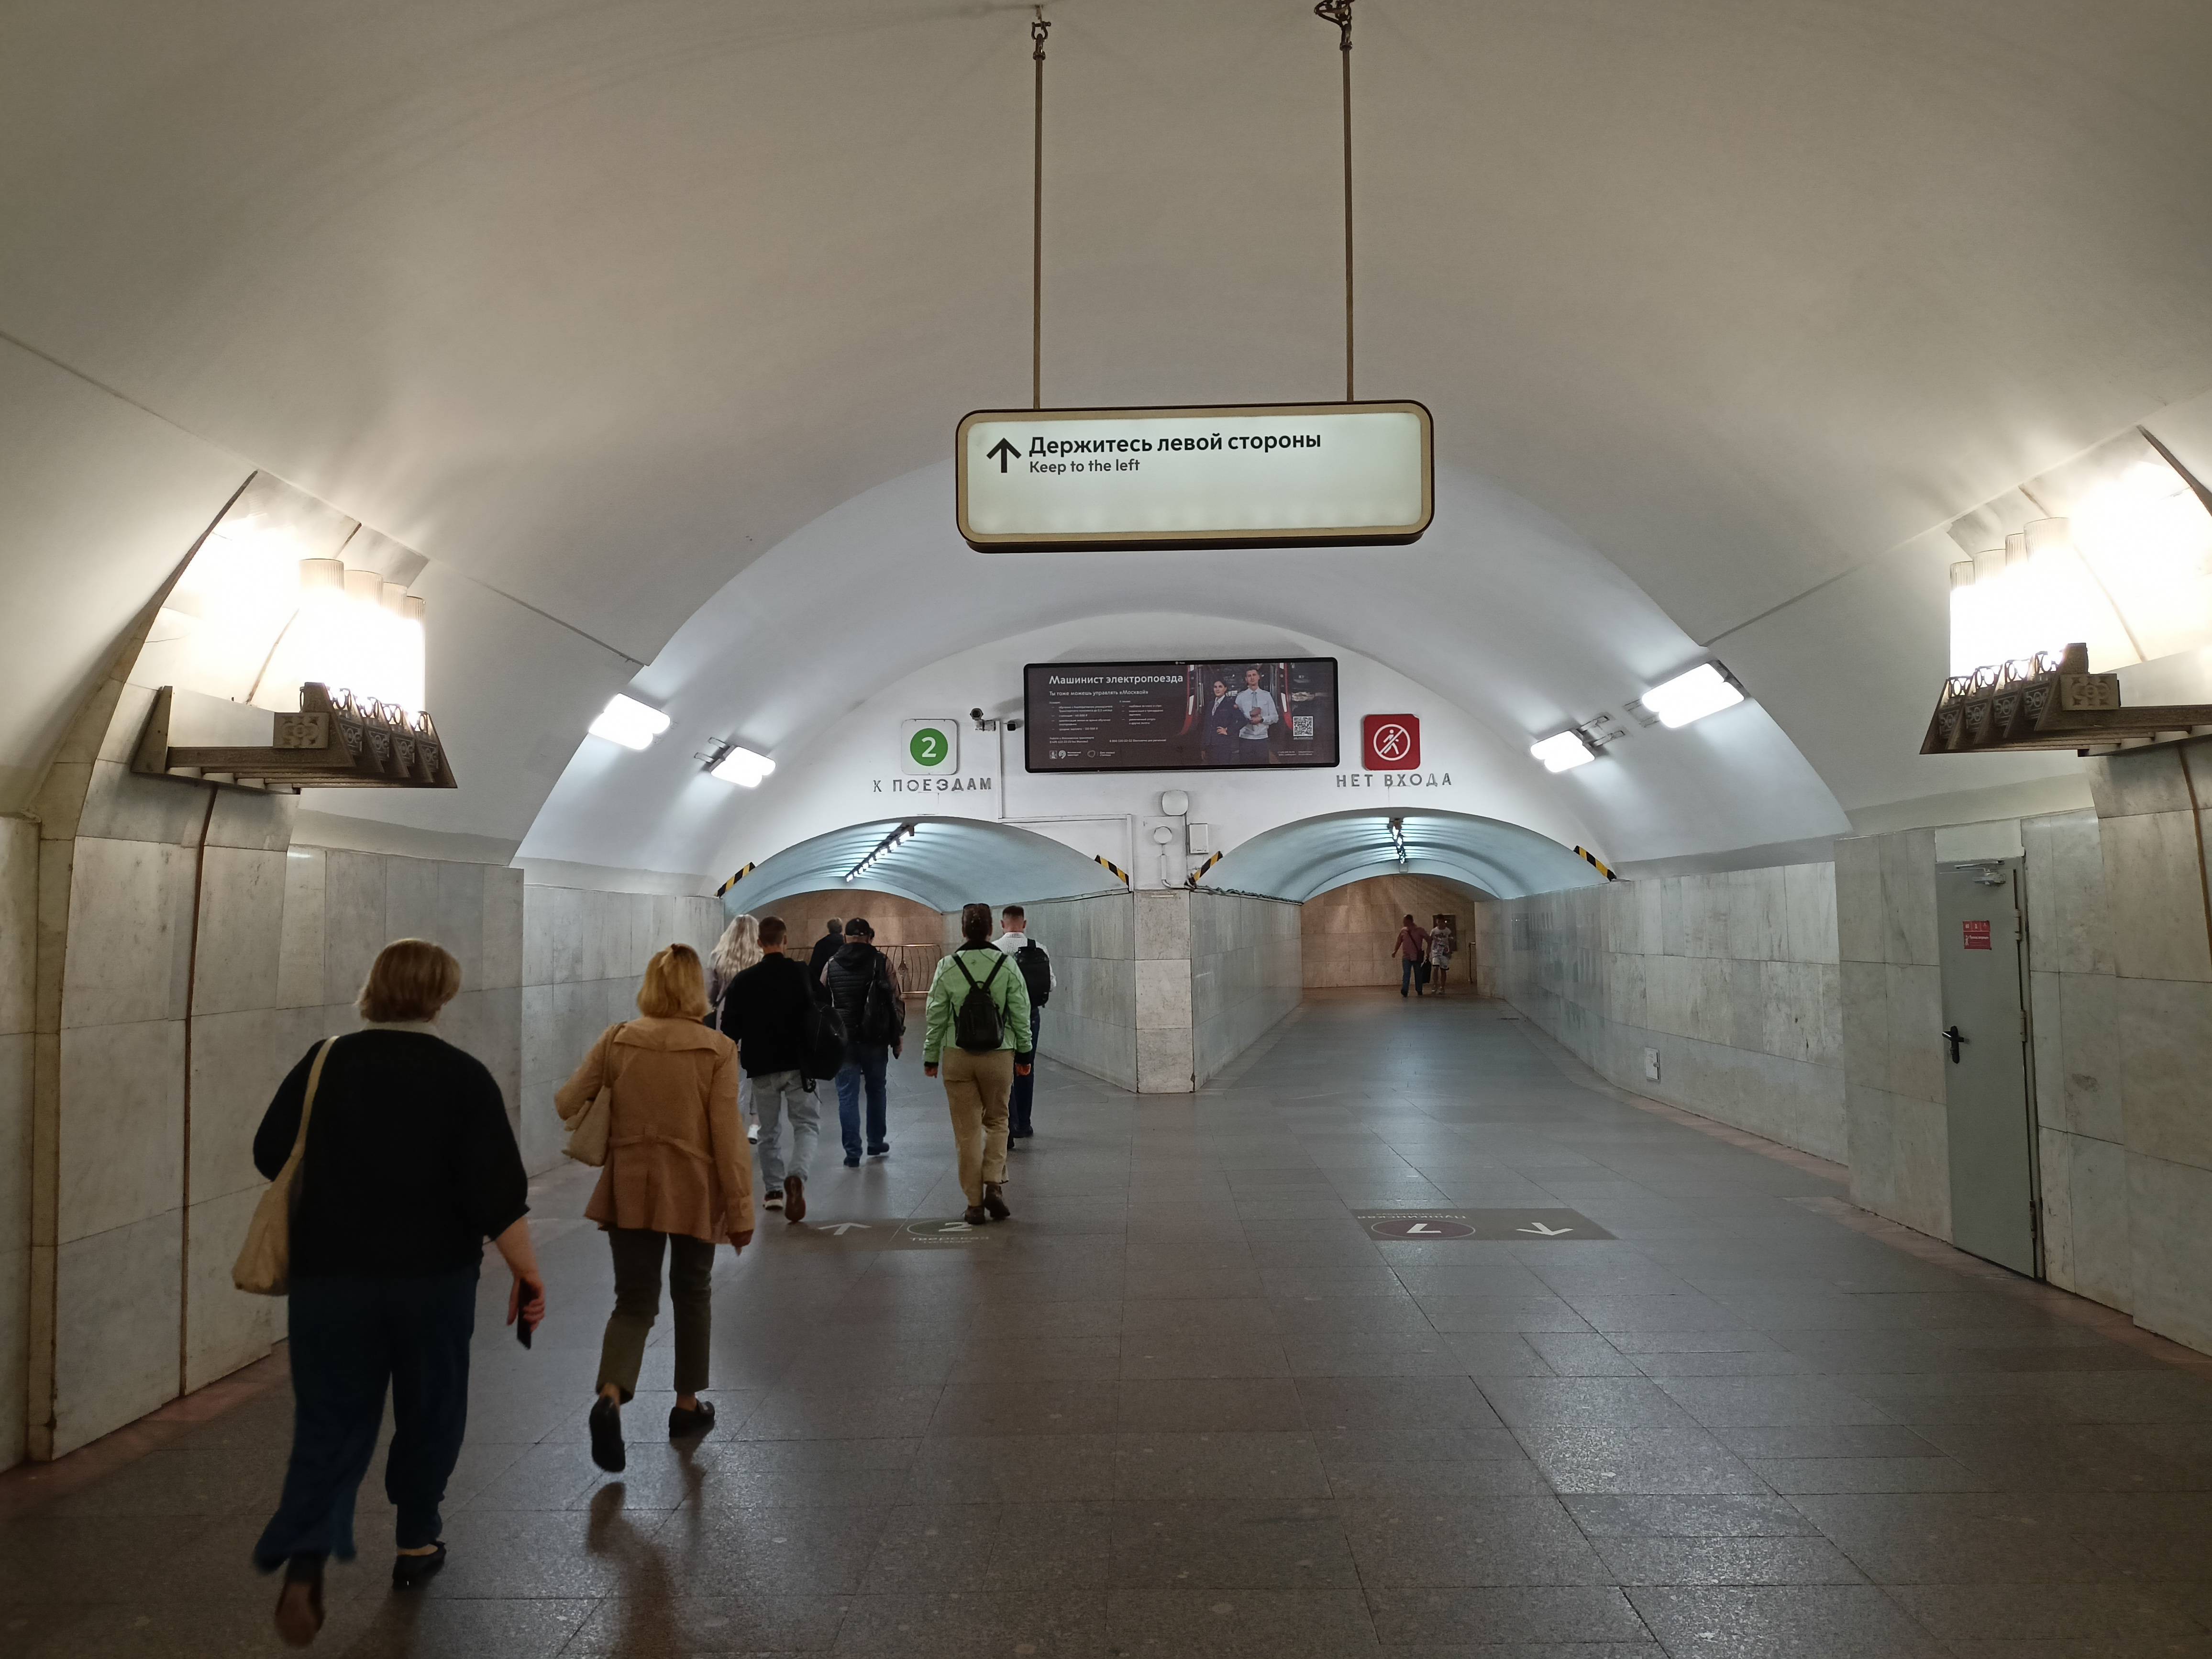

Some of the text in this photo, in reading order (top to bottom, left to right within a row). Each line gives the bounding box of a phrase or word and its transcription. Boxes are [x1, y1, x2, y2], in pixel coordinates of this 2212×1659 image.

[1029, 432, 1321, 458] Держитесь левой стороны
[1029, 458, 1140, 475] Keep to the left
[1049, 675, 1183, 685] Машинист электропоезда
[921, 736, 937, 758] 2
[873, 778, 992, 793] К ПОЕЗДАМ
[1336, 773, 1452, 787] НЕТ ВХОДА
[938, 1221, 973, 1232] 2
[1406, 1223, 1442, 1234] 7
